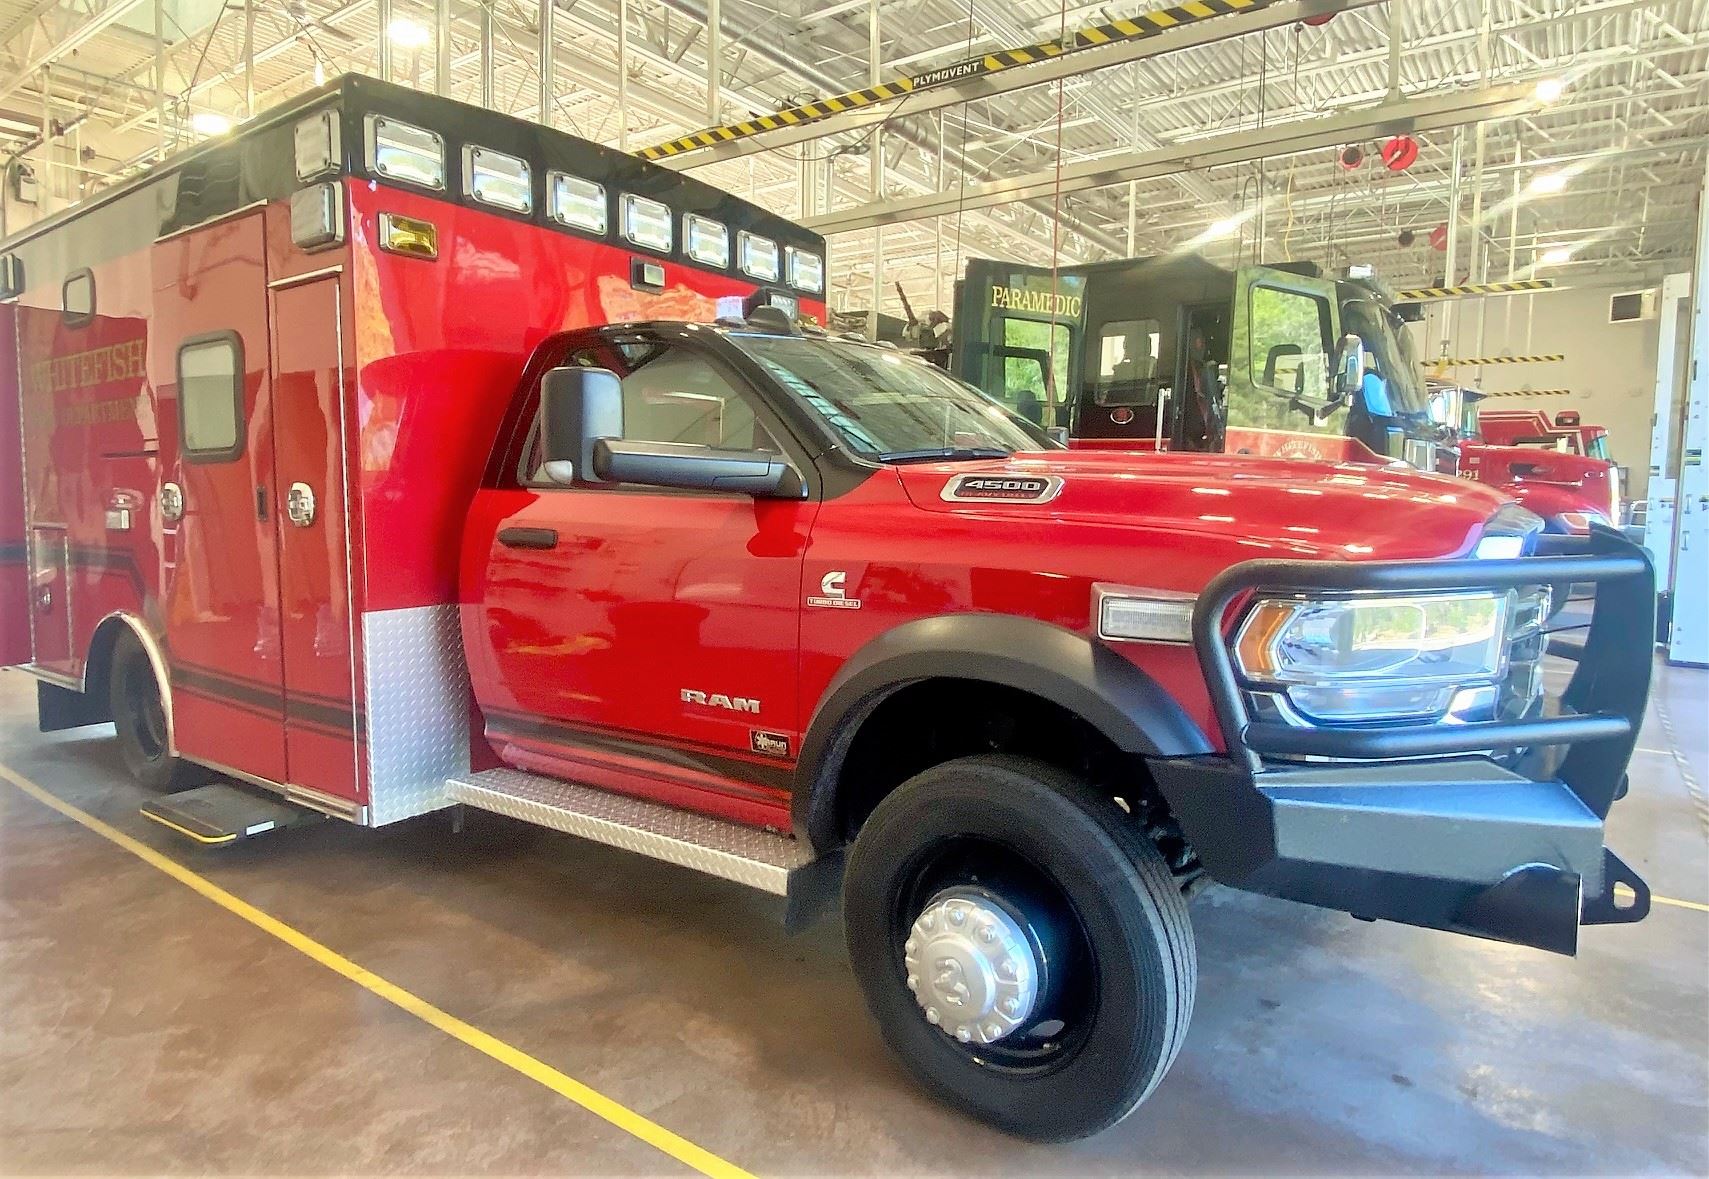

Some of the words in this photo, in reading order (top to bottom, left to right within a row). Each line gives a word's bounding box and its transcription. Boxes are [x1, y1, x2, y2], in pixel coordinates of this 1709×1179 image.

[914, 62, 979, 87] PLYMOVENT
[991, 286, 1081, 317] PARAMEDIC
[31, 339, 146, 392] WHITEFISH
[965, 480, 1040, 491] 4500
[681, 688, 761, 714] RAM
